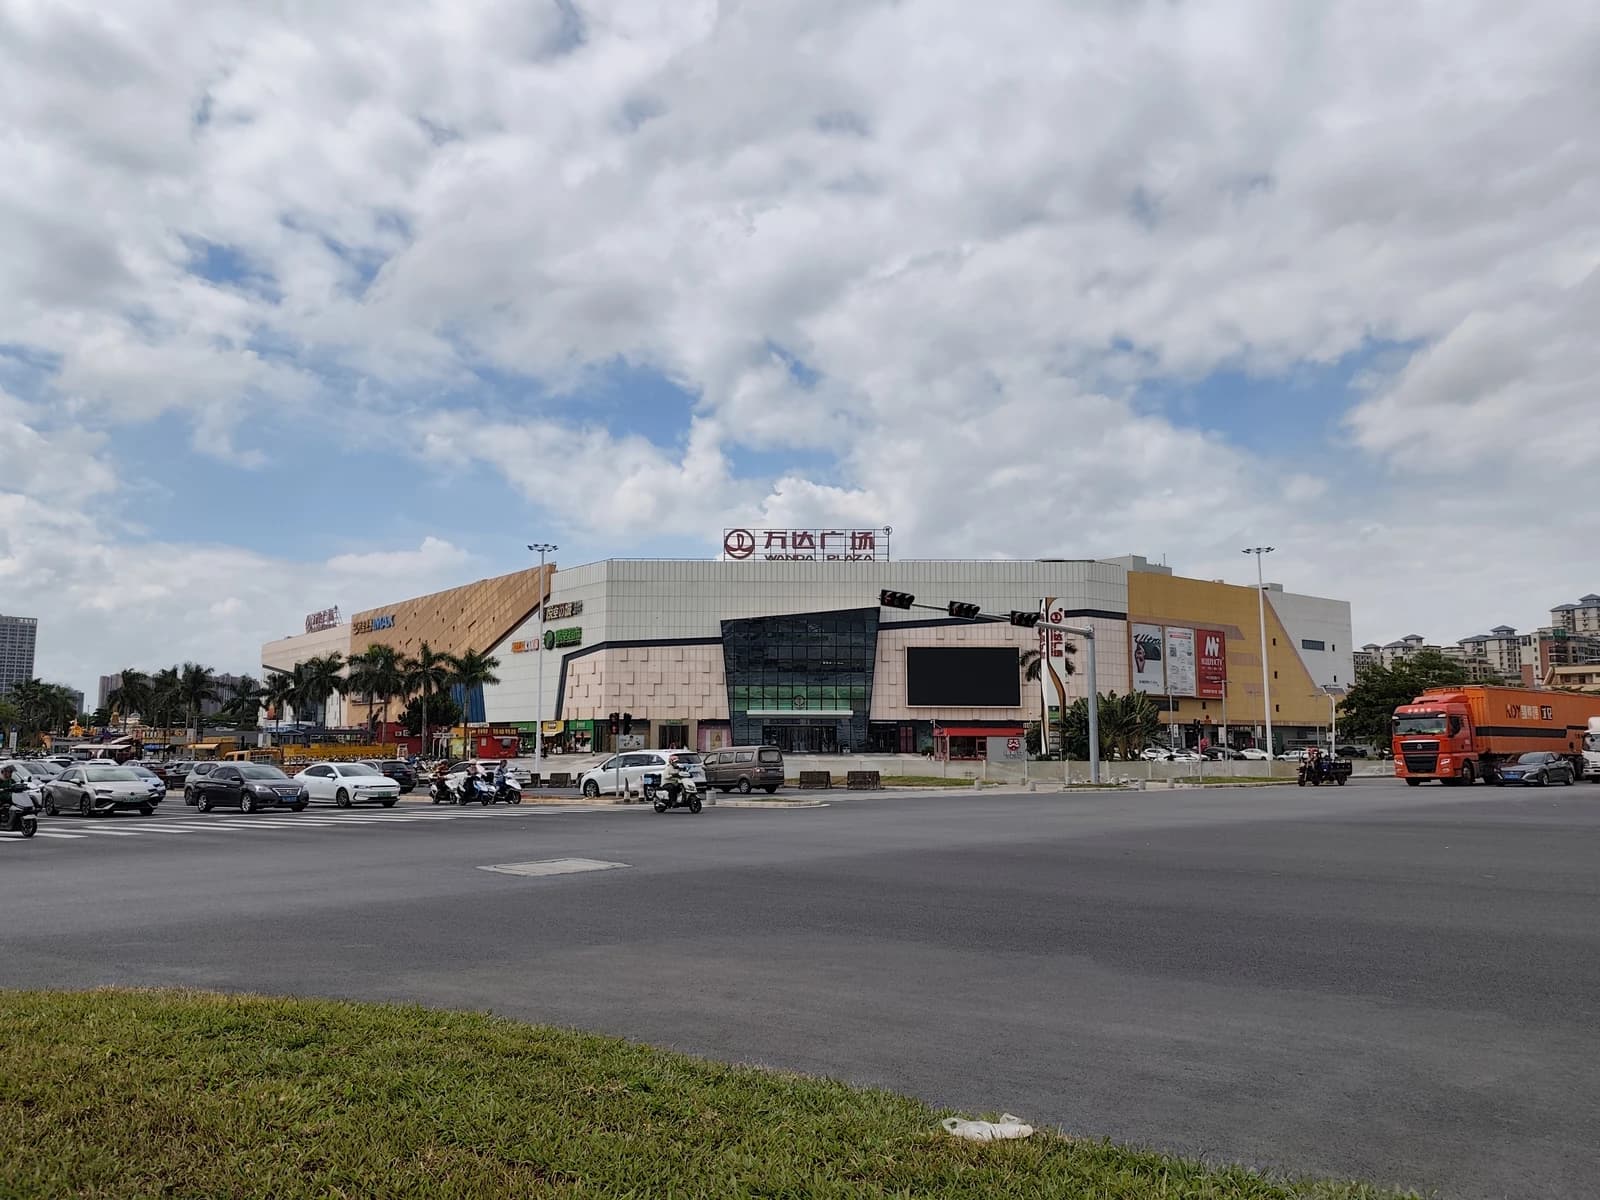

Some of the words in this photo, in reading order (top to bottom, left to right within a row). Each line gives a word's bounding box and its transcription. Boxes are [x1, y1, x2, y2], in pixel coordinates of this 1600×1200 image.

[763, 531, 875, 550] 万达广场
[373, 614, 396, 631] IMAX
